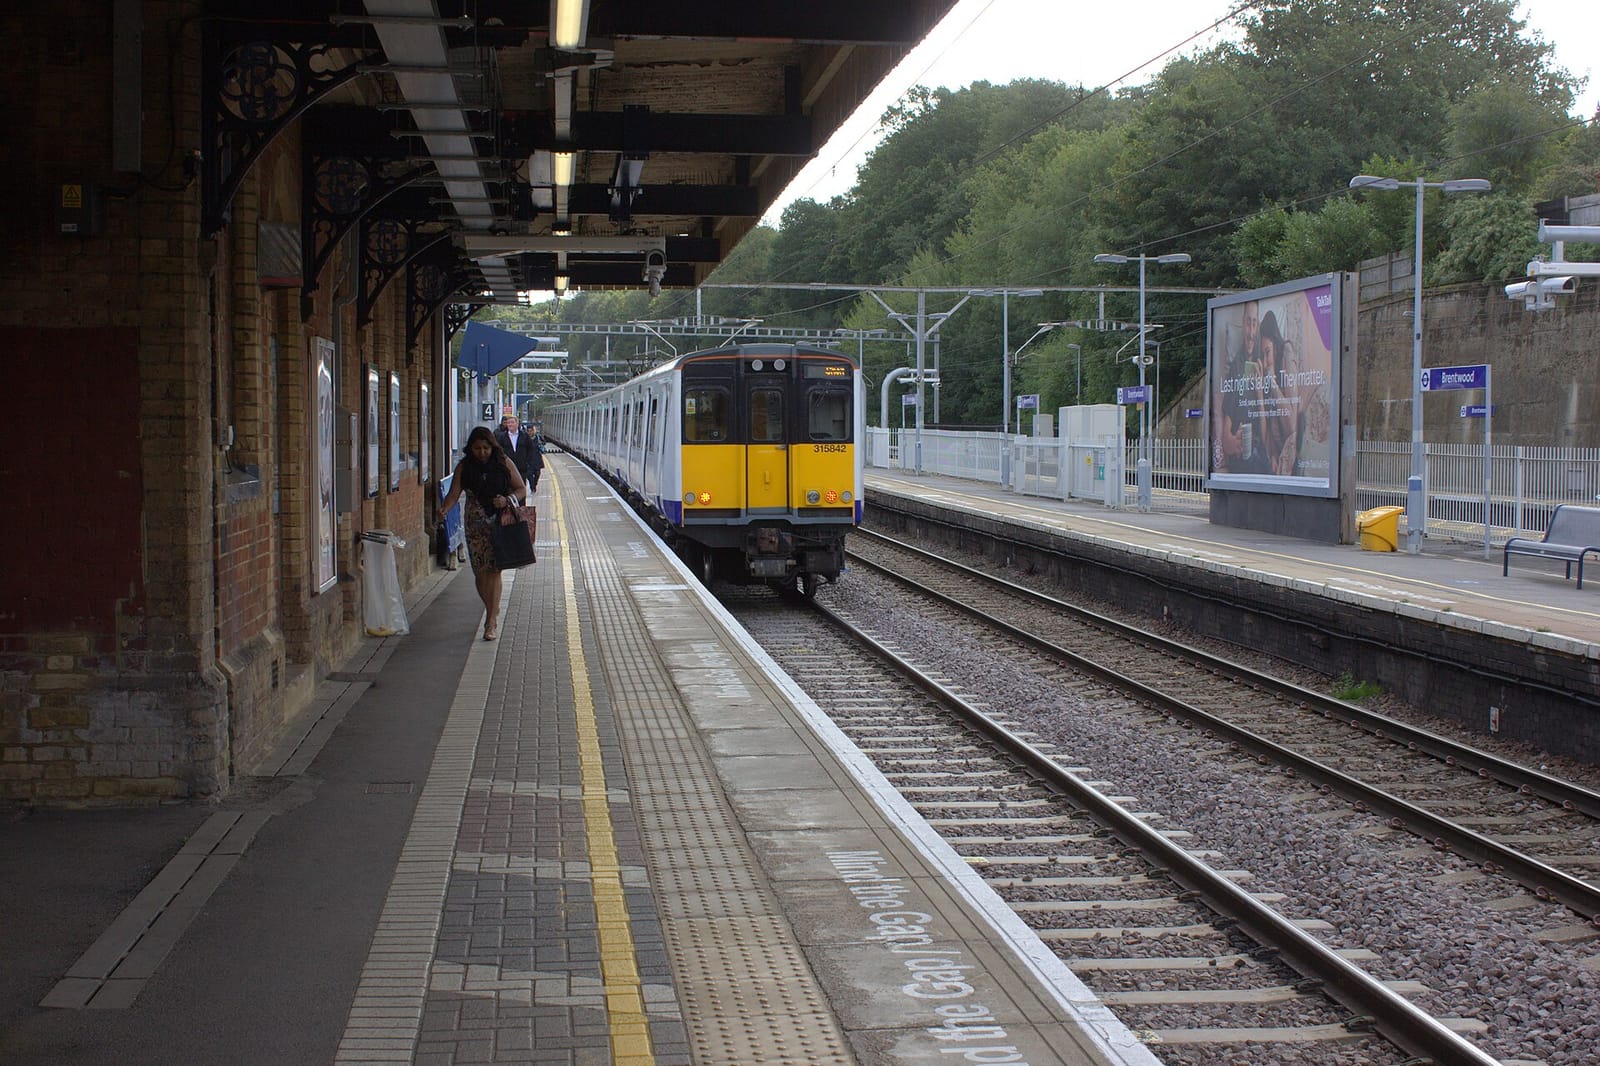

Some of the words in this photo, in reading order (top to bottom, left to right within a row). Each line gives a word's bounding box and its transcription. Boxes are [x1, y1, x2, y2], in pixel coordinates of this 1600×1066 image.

[1220, 376, 1234, 393] Last
[1234, 374, 1254, 396] night's
[1279, 370, 1297, 391] They
[1298, 369, 1326, 386] matter.
[1442, 371, 1475, 383] Brentwood
[485, 405, 493, 416] 4
[814, 445, 847, 453] 315842
[825, 850, 902, 883] Mind
[849, 884, 911, 909] the
[864, 911, 933, 946] Gap
[902, 957, 976, 999] Gap
[926, 1003, 1008, 1042] the
